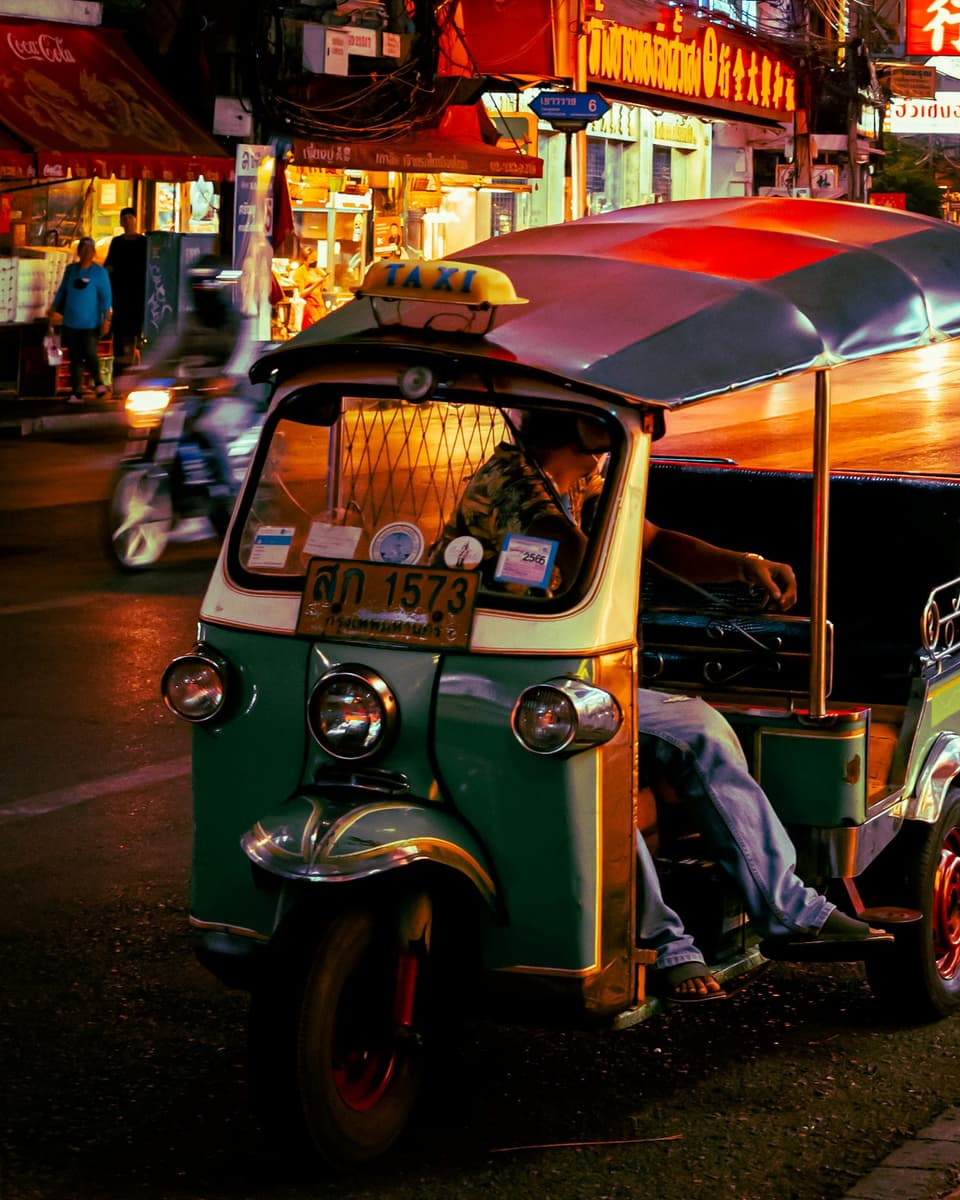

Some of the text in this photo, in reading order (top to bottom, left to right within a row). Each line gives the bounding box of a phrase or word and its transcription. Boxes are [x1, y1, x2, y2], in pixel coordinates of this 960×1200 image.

[7, 32, 77, 63] Coca-Cola
[588, 99, 597, 112] 6
[384, 263, 477, 293] TAXI
[385, 570, 470, 615] 1573
